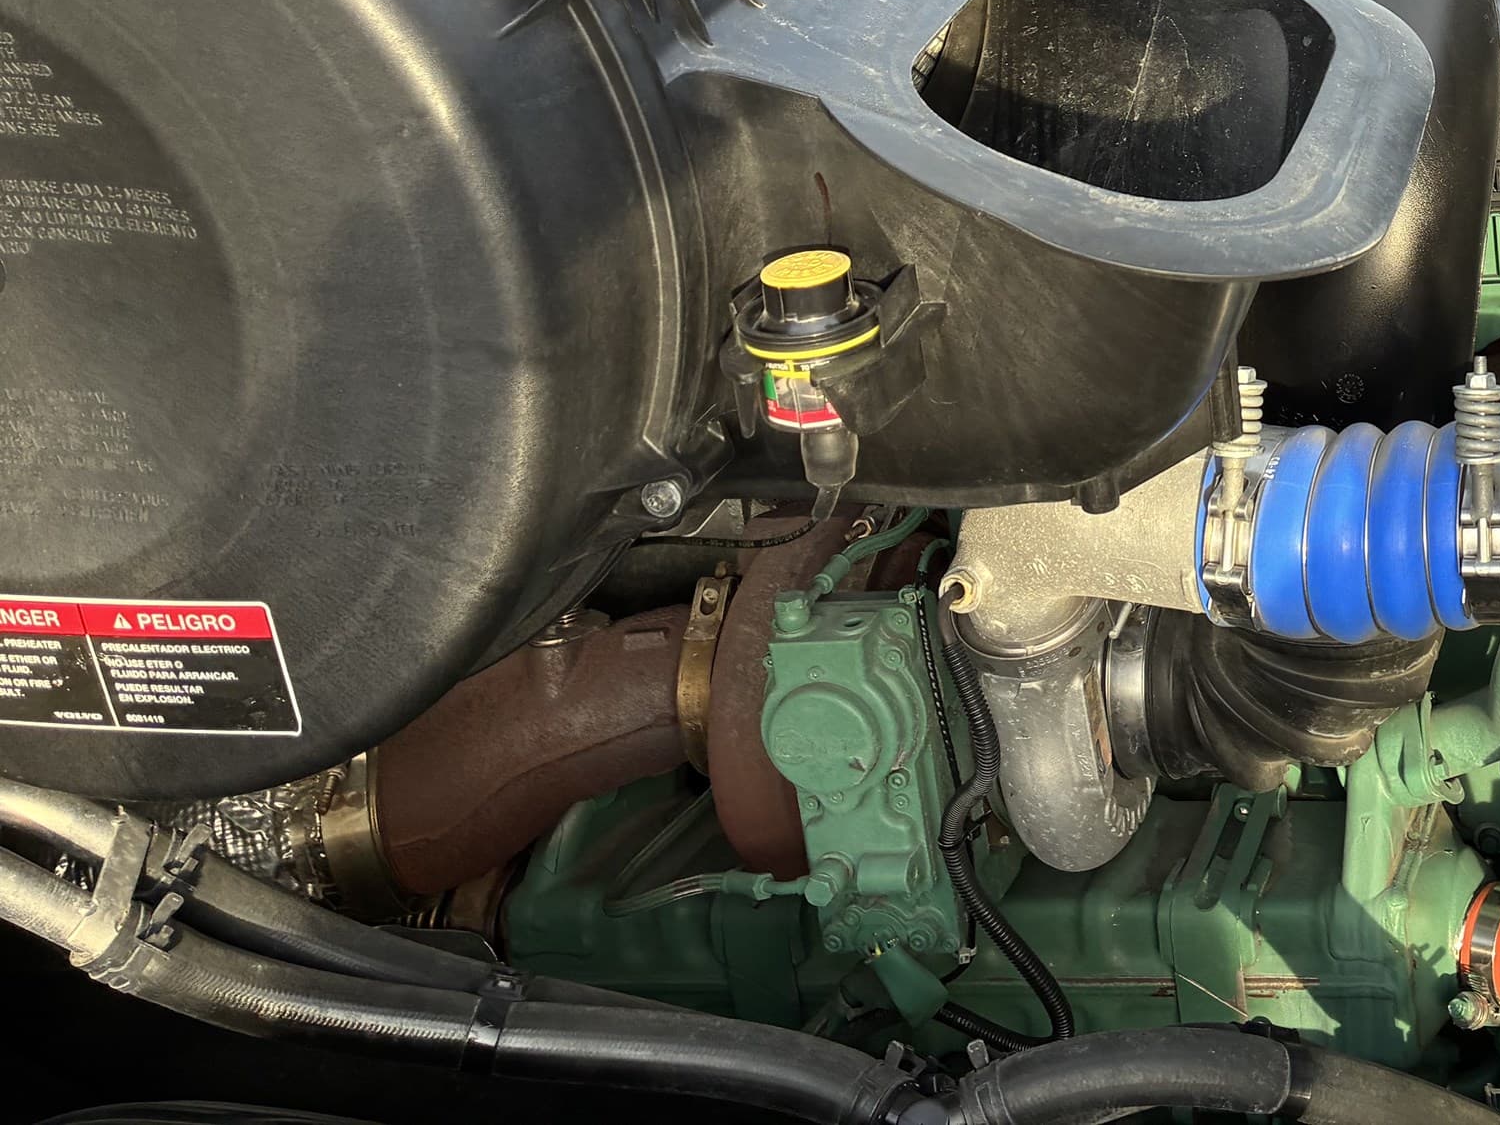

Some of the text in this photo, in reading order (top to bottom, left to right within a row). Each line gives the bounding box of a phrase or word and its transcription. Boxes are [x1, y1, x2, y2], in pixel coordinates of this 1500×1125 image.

[0, 608, 236, 631] NGER PELIGRO
[4, 638, 250, 655] PREHEATER PRECALENTADOR ELECTRICO
[8, 654, 41, 664] ETHER
[41, 655, 58, 665] OR
[124, 659, 145, 668] USE
[146, 660, 173, 669] ETER
[1, 664, 33, 675] FLUID.
[110, 669, 239, 681] FLUIDO PARA ARRANCAR.
[28, 680, 52, 689] FIRE
[115, 682, 205, 695] PUEDE RESULTAR
[118, 693, 195, 705] EN EXPLOSION.
[53, 711, 104, 721] VOLVO
